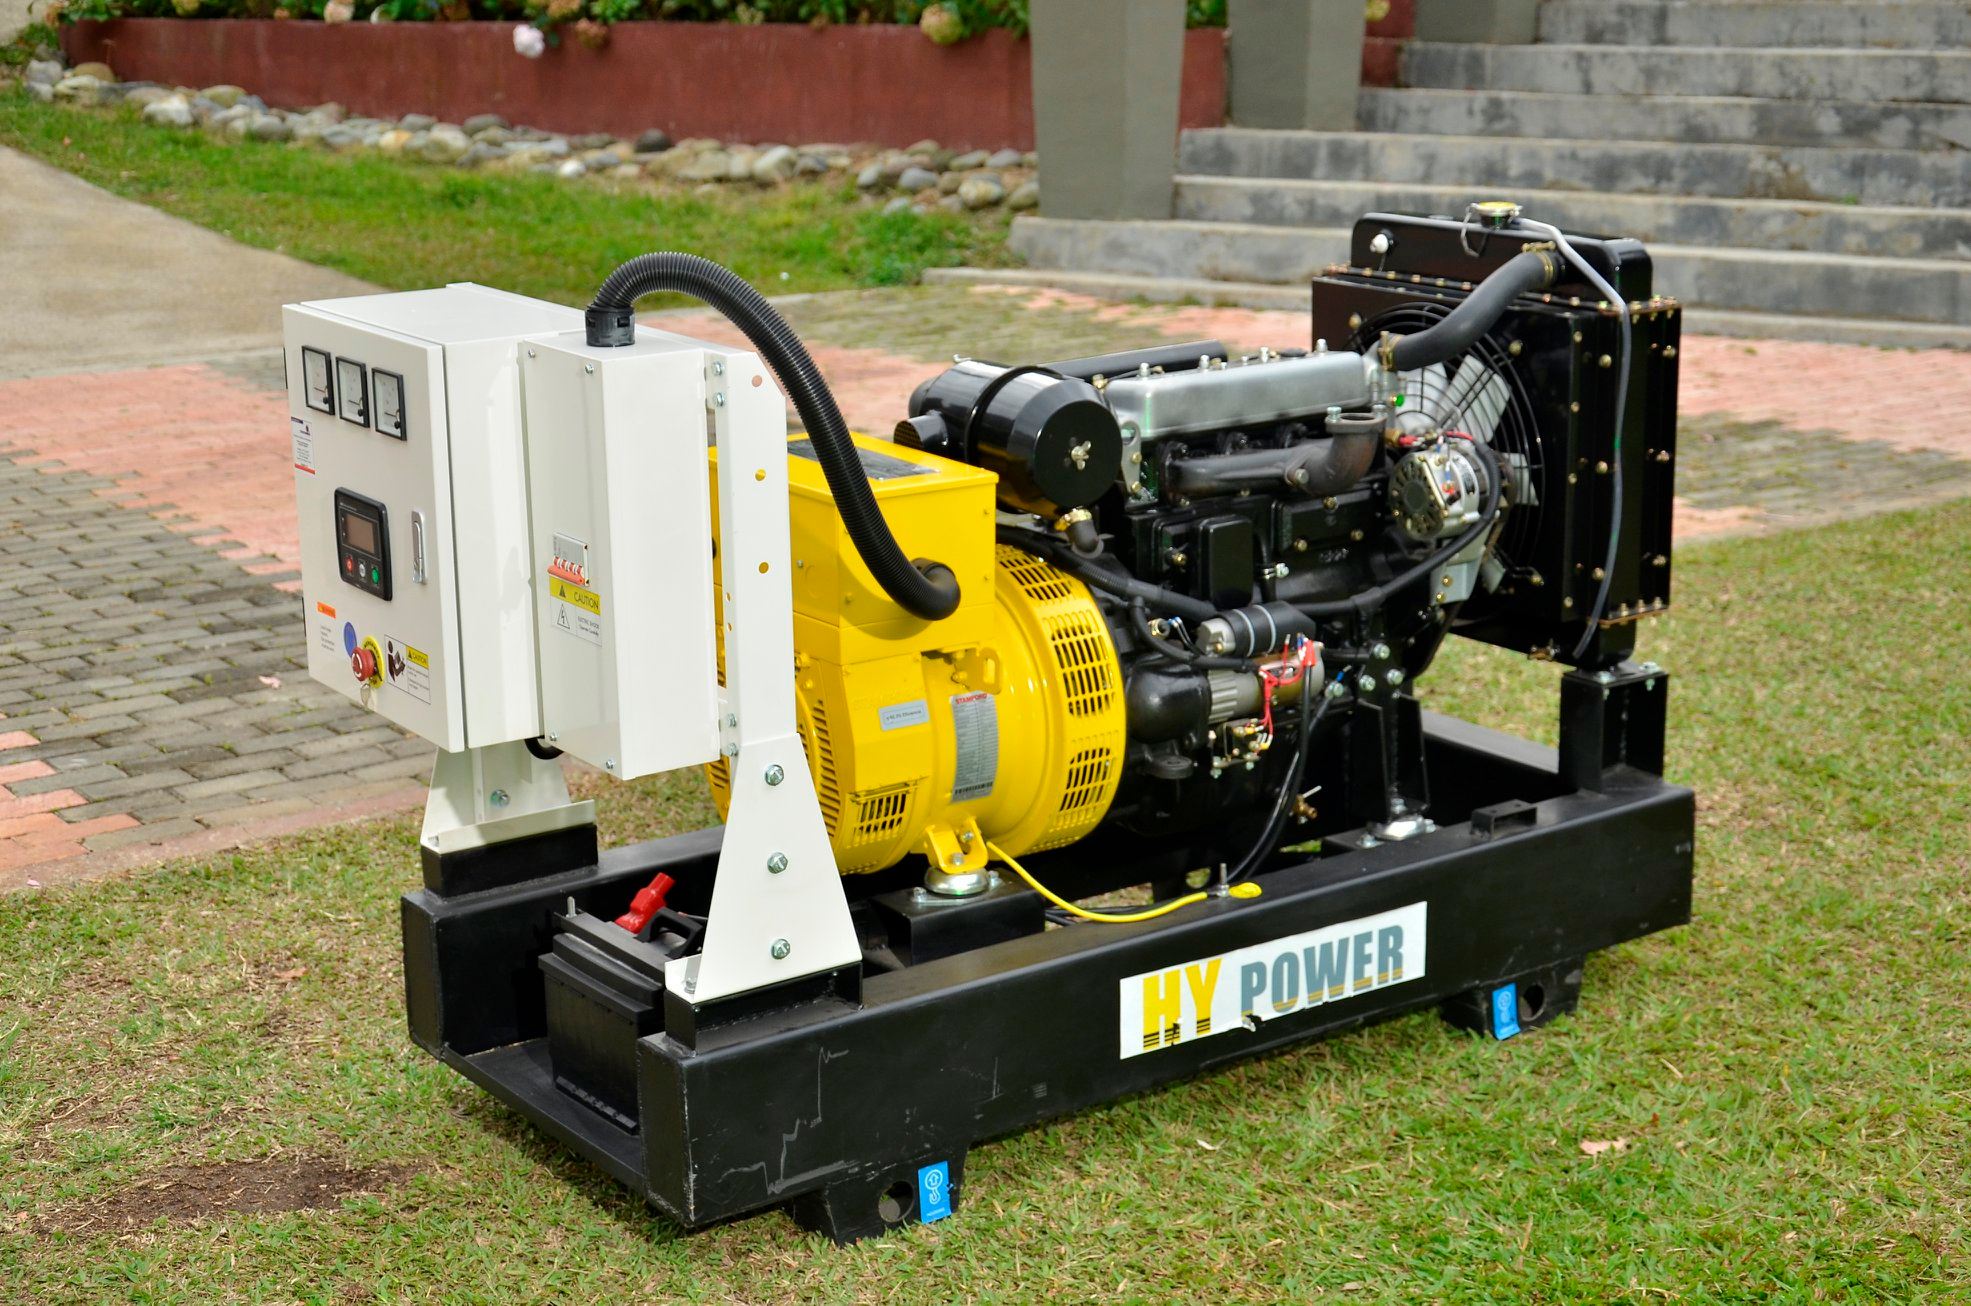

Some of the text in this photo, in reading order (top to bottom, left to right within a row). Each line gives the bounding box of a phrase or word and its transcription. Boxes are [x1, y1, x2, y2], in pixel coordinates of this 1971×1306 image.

[574, 591, 599, 610] CAUTION
[955, 692, 988, 704] STAMFORD
[1142, 924, 1404, 1052] HY POWER
